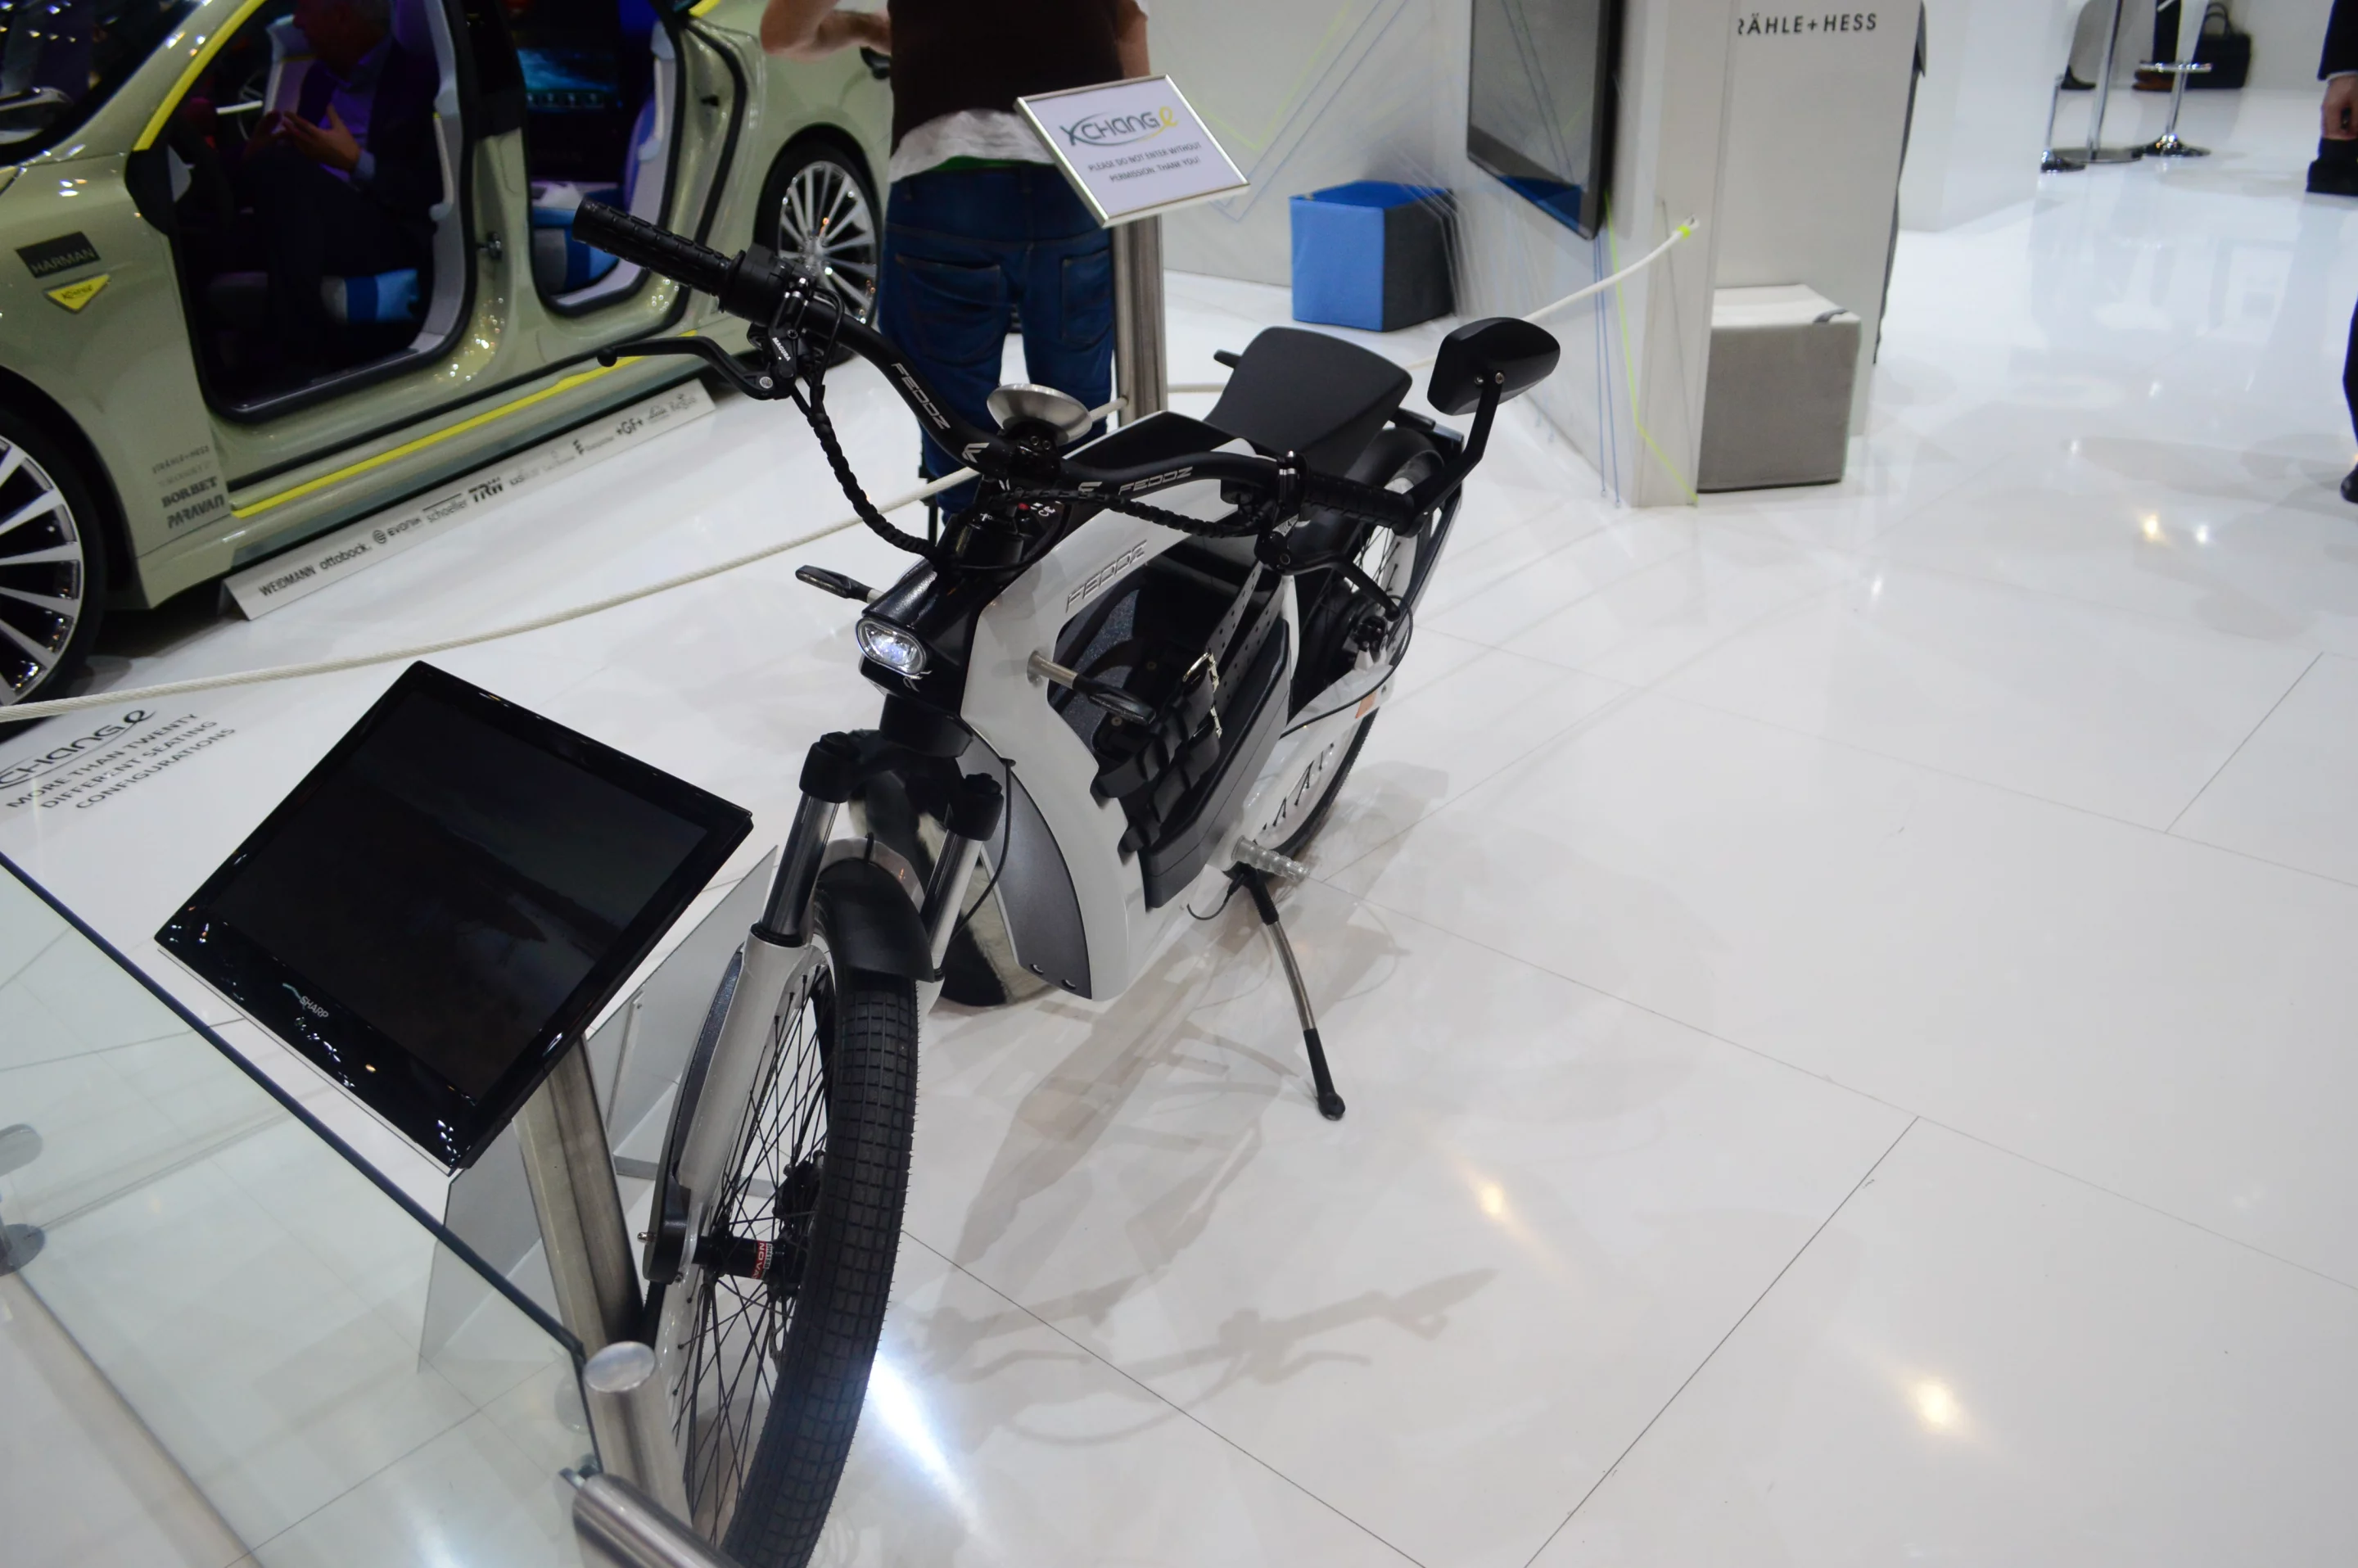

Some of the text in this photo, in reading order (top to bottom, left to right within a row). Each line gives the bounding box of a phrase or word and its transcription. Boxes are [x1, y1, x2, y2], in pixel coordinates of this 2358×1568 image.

[1088, 142, 1202, 171] PLEASE DO NOT ENTER WITHOUT
[1159, 160, 1181, 173] THANK
[31, 248, 97, 274] HARMAN
[772, 337, 791, 361] MAGURA
[891, 363, 951, 429] FEDDZ
[161, 476, 217, 508] BORBET
[1118, 466, 1193, 495] FEDDZ
[258, 564, 316, 597] WEIDMANN
[427, 498, 468, 523] schoeller
[468, 476, 504, 504] TRW
[1065, 539, 1147, 613] FEDDZ
[7, 712, 199, 808] MORE THAN TWENTY
[40, 721, 217, 809] DIFFERENT SEATING
[75, 727, 236, 809] CONFIGURATIONS
[300, 996, 329, 1018] SHARP
[752, 1242, 765, 1280] NOVA
